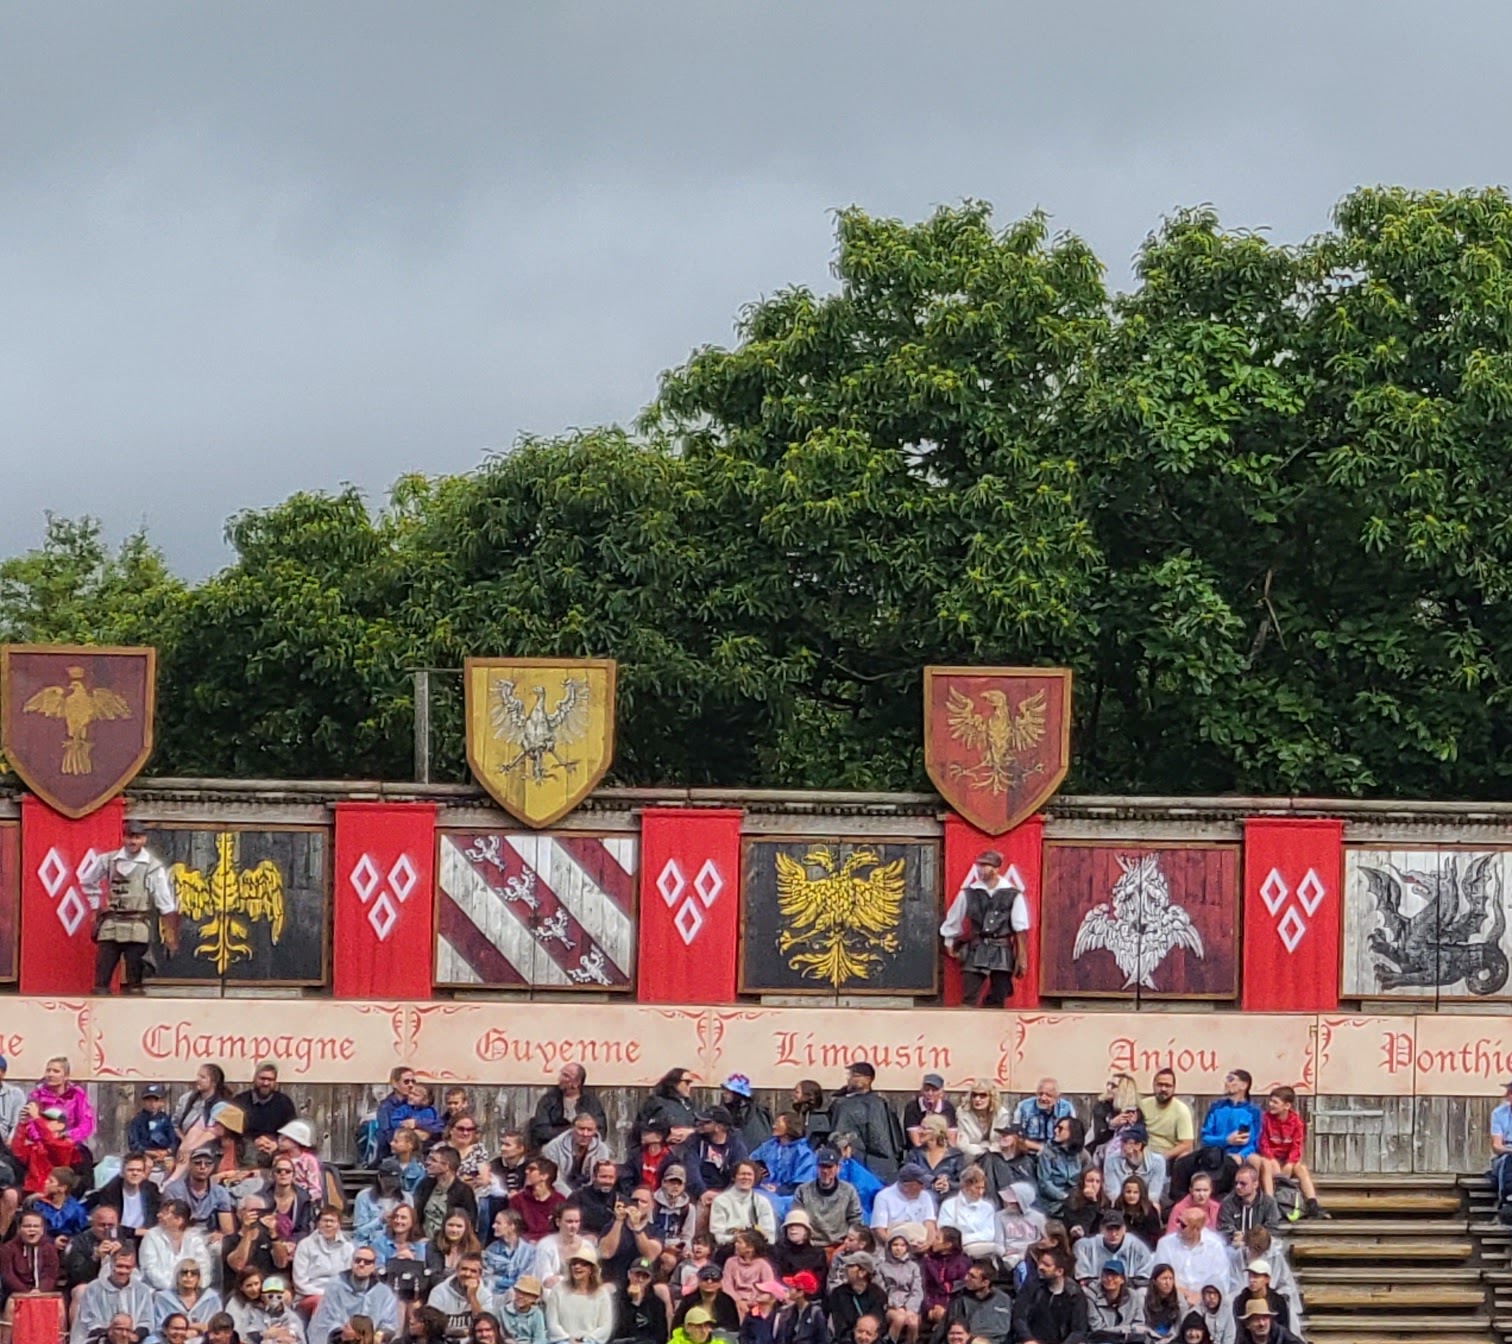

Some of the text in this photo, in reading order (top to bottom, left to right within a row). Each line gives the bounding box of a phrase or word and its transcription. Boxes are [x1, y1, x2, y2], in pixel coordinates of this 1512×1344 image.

[141, 1022, 356, 1073] Champagne
[475, 1028, 641, 1073] Guyenne
[773, 1030, 952, 1067] Limousin
[1107, 1037, 1220, 1075] Anjou
